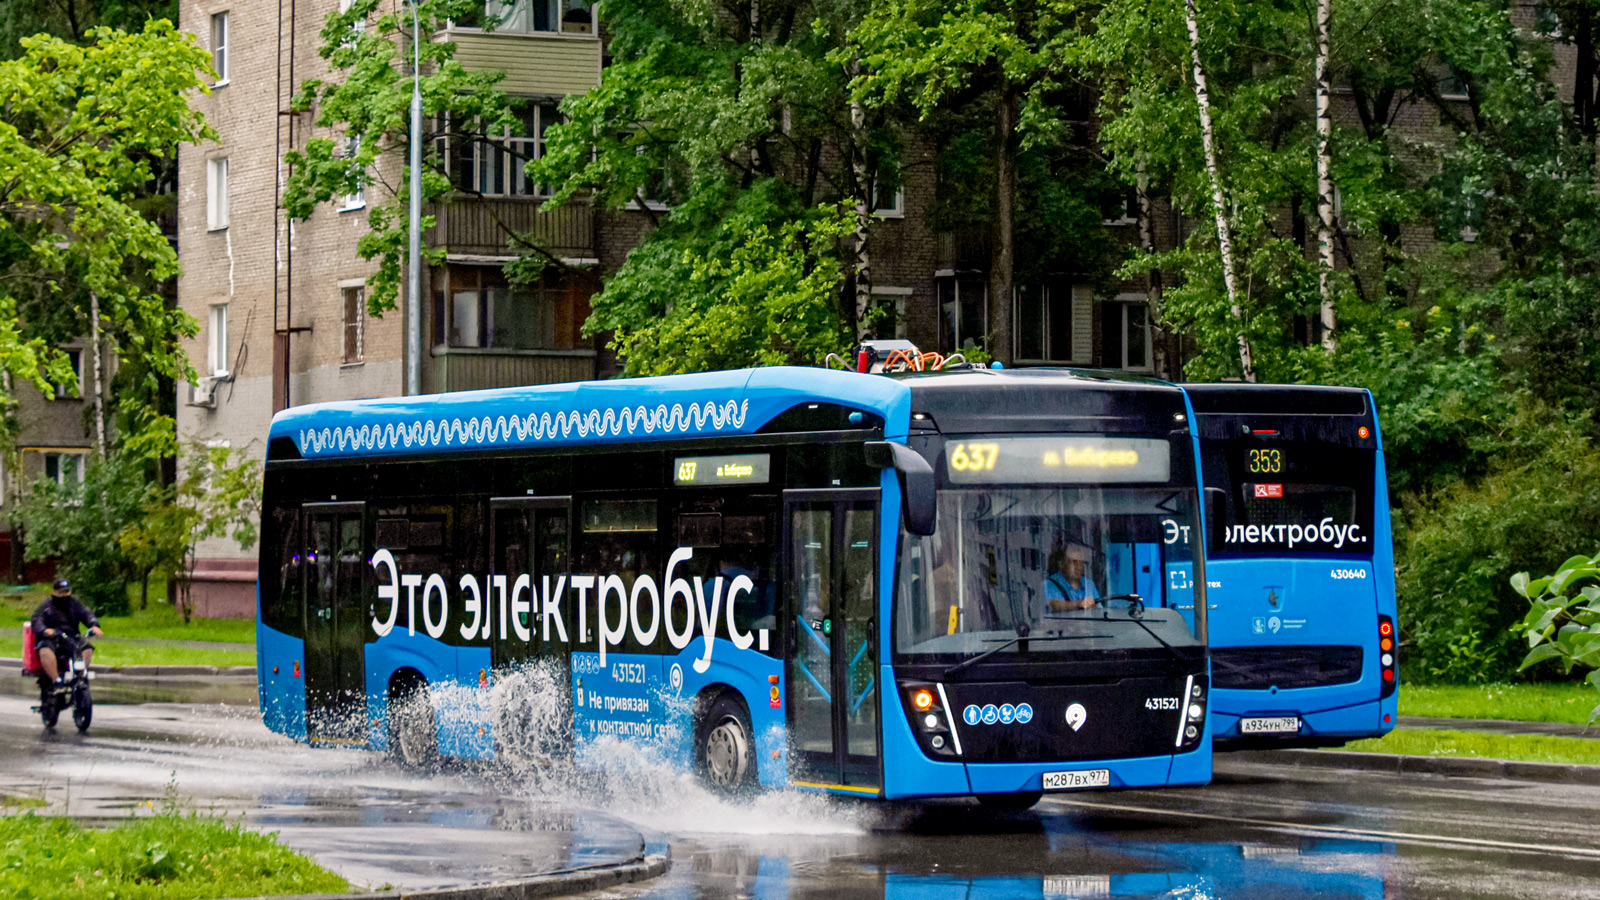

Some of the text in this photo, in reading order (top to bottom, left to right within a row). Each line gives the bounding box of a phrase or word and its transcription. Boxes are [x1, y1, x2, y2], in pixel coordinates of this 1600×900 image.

[951, 443, 999, 471] 637
[1250, 449, 1280, 472] 353
[678, 462, 697, 481] 637
[1330, 569, 1366, 579] 430640
[371, 546, 769, 674] Это электробус.
[612, 663, 646, 683] 431521
[589, 691, 649, 714] Не привязан
[1145, 698, 1179, 710] 431521
[589, 720, 596, 732] к
[597, 718, 653, 737] контактной
[1046, 771, 1106, 787] М287ВХ 977
